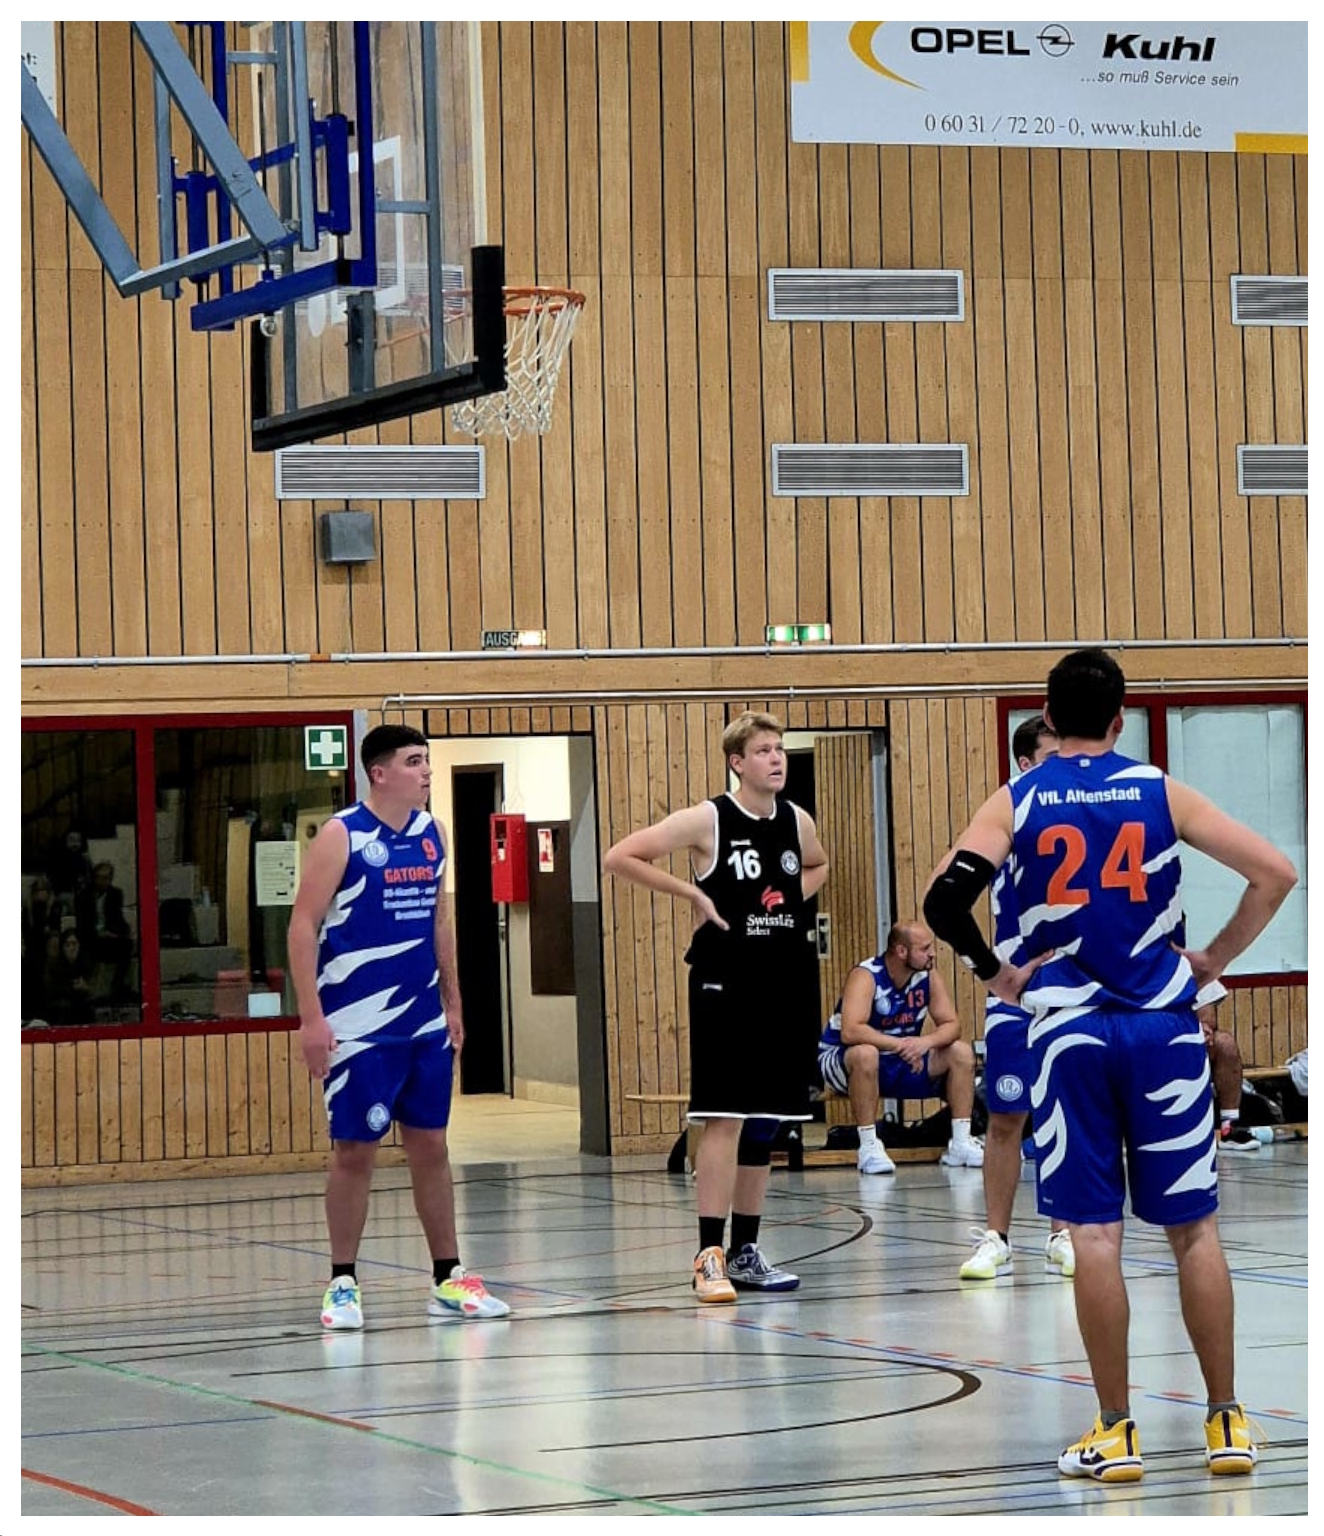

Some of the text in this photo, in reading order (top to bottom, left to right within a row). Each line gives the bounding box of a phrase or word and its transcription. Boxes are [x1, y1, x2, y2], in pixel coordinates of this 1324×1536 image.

[910, 27, 1216, 62] OPEL Kuhl
[1119, 70, 1149, 83] muß
[1154, 71, 1206, 85] Service
[1211, 73, 1239, 87] sein
[941, 114, 963, 133] 60
[968, 115, 984, 133] 31
[1008, 116, 1027, 134] 72
[1091, 119, 1202, 138] www.kuhl.de
[1037, 786, 1142, 806] VfL Altenstadt
[421, 838, 438, 862] 9
[384, 865, 435, 884] GATORS
[727, 849, 762, 880] 16
[1036, 821, 1149, 906] 24
